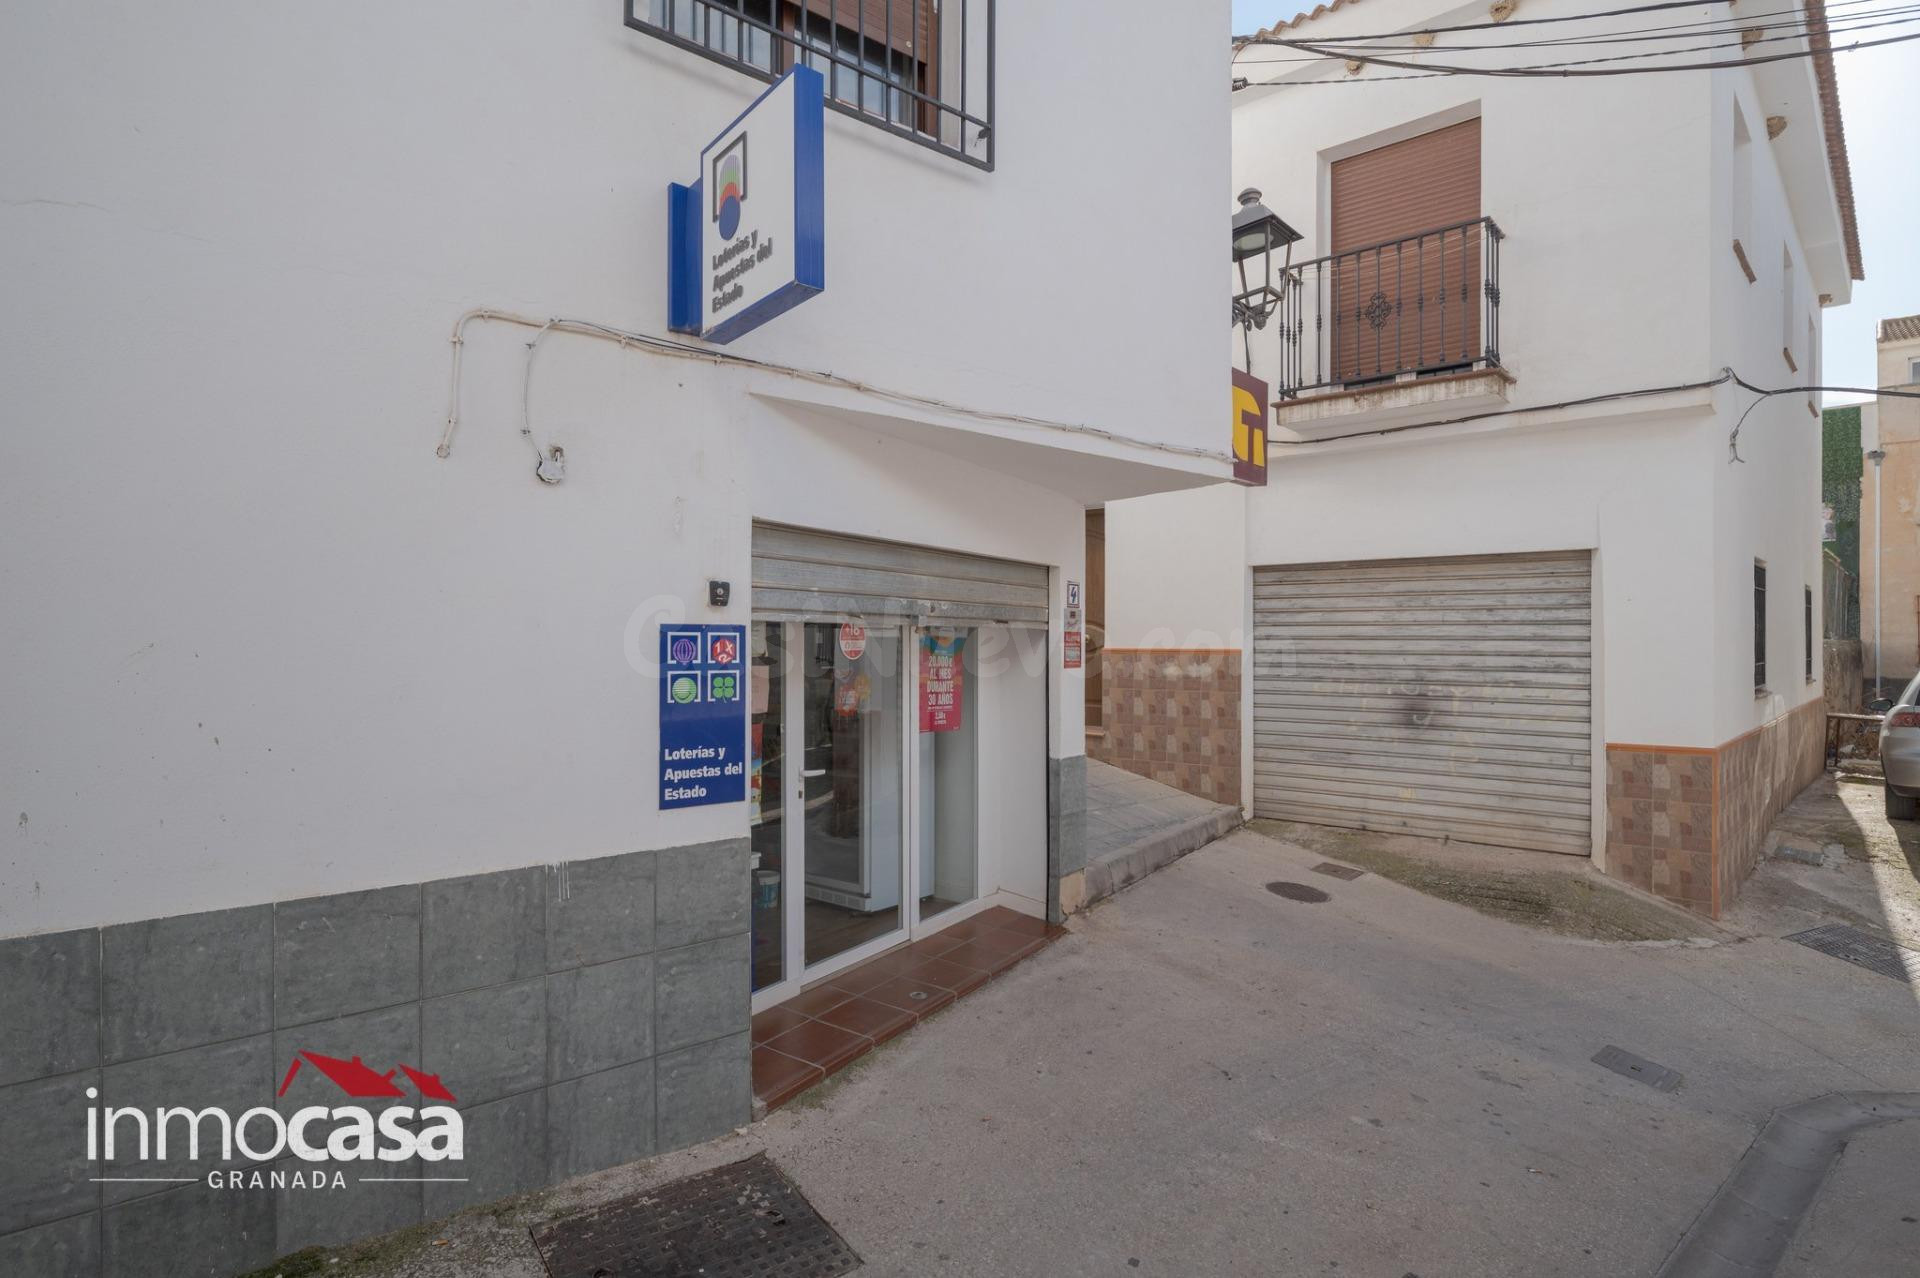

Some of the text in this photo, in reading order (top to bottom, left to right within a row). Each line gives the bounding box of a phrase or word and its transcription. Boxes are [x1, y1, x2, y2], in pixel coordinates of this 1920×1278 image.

[712, 229, 758, 270] Loterías y
[712, 237, 773, 292] Apuestas del
[712, 283, 744, 313] Estado
[927, 681, 953, 692] DURANTE
[664, 746, 726, 761] Loterías y
[664, 762, 743, 783] Apuestas del
[664, 785, 707, 801] Estado
